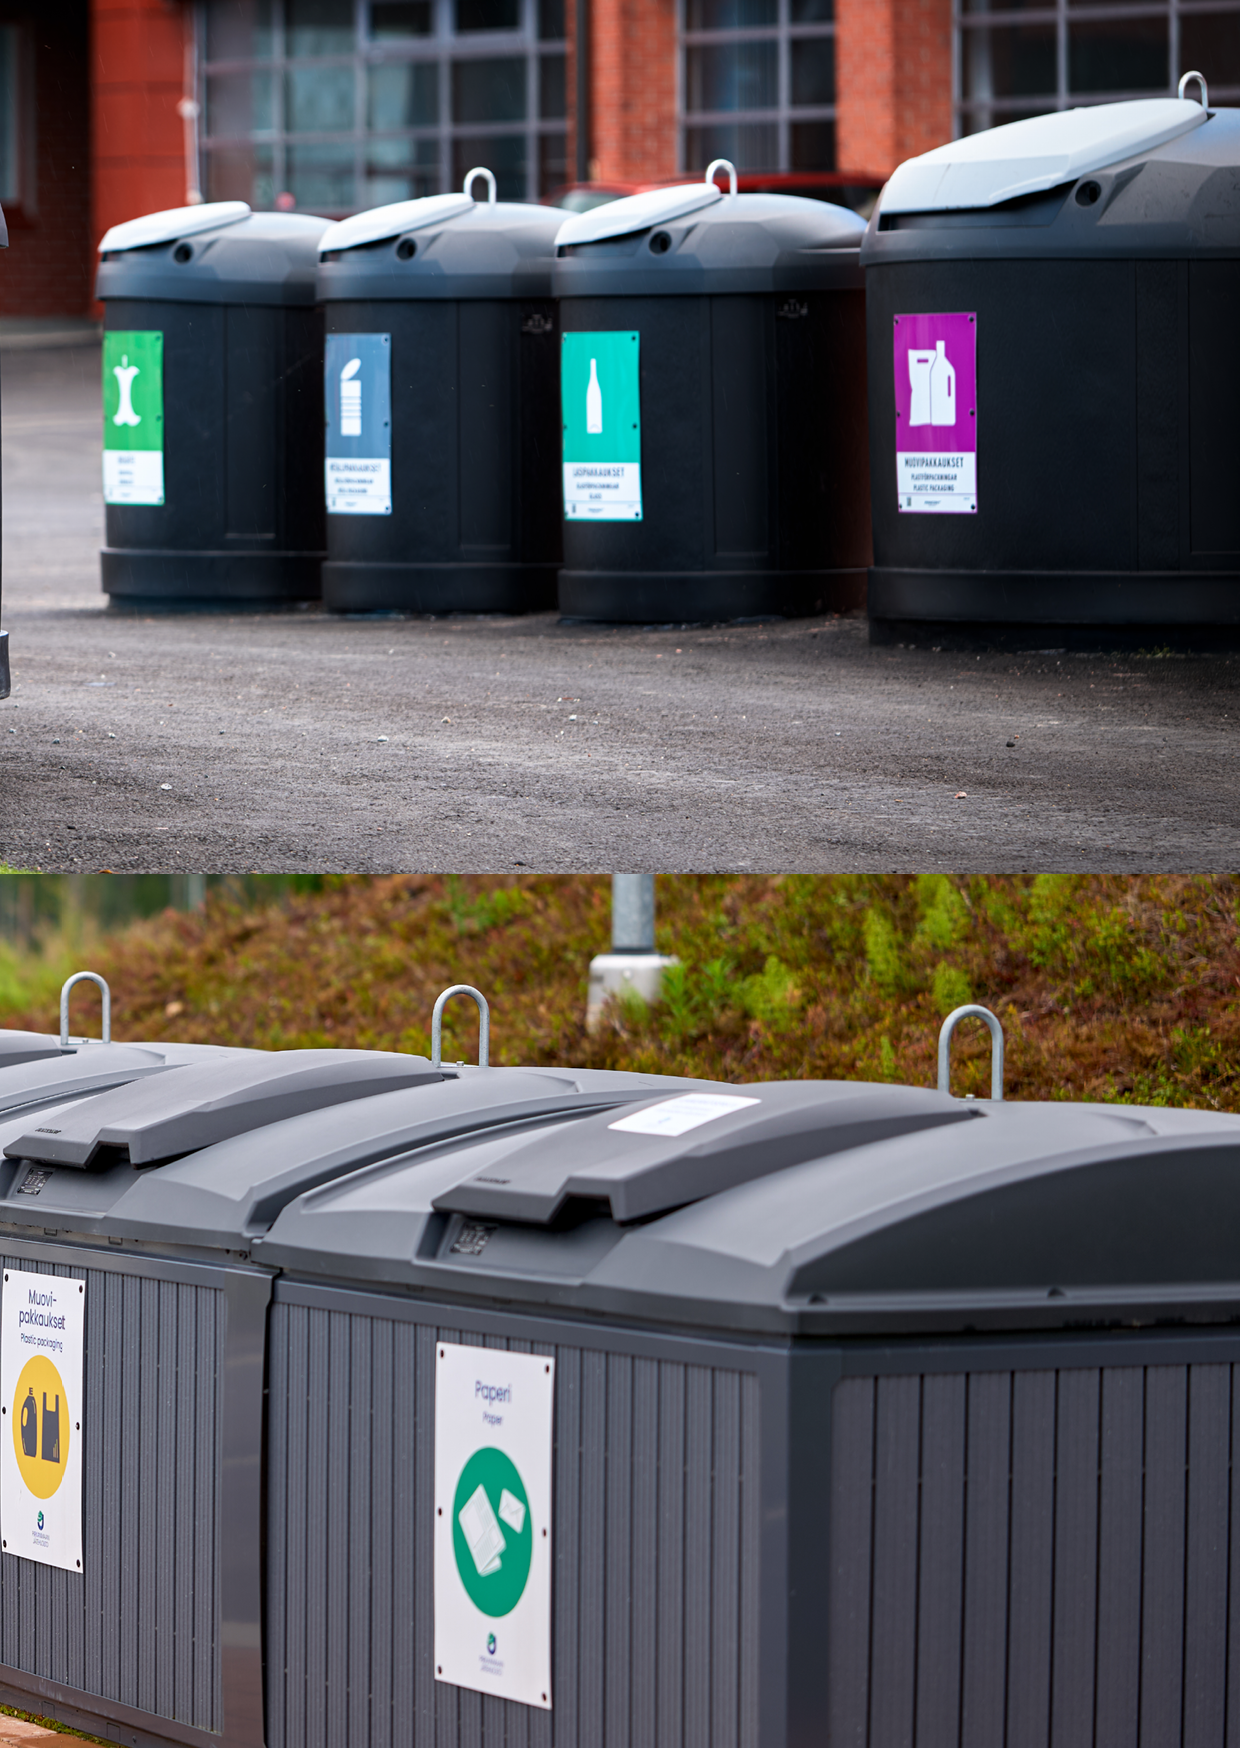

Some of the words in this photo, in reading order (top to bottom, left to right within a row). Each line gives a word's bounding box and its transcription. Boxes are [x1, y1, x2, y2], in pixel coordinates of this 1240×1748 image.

[28, 1288, 57, 1307] Muovi-
[18, 1308, 66, 1330] pakkaukset
[20, 1332, 36, 1345] Plastic
[37, 1337, 63, 1353] packaging
[475, 1380, 512, 1407] Paperi
[482, 1410, 503, 1427] Paper
